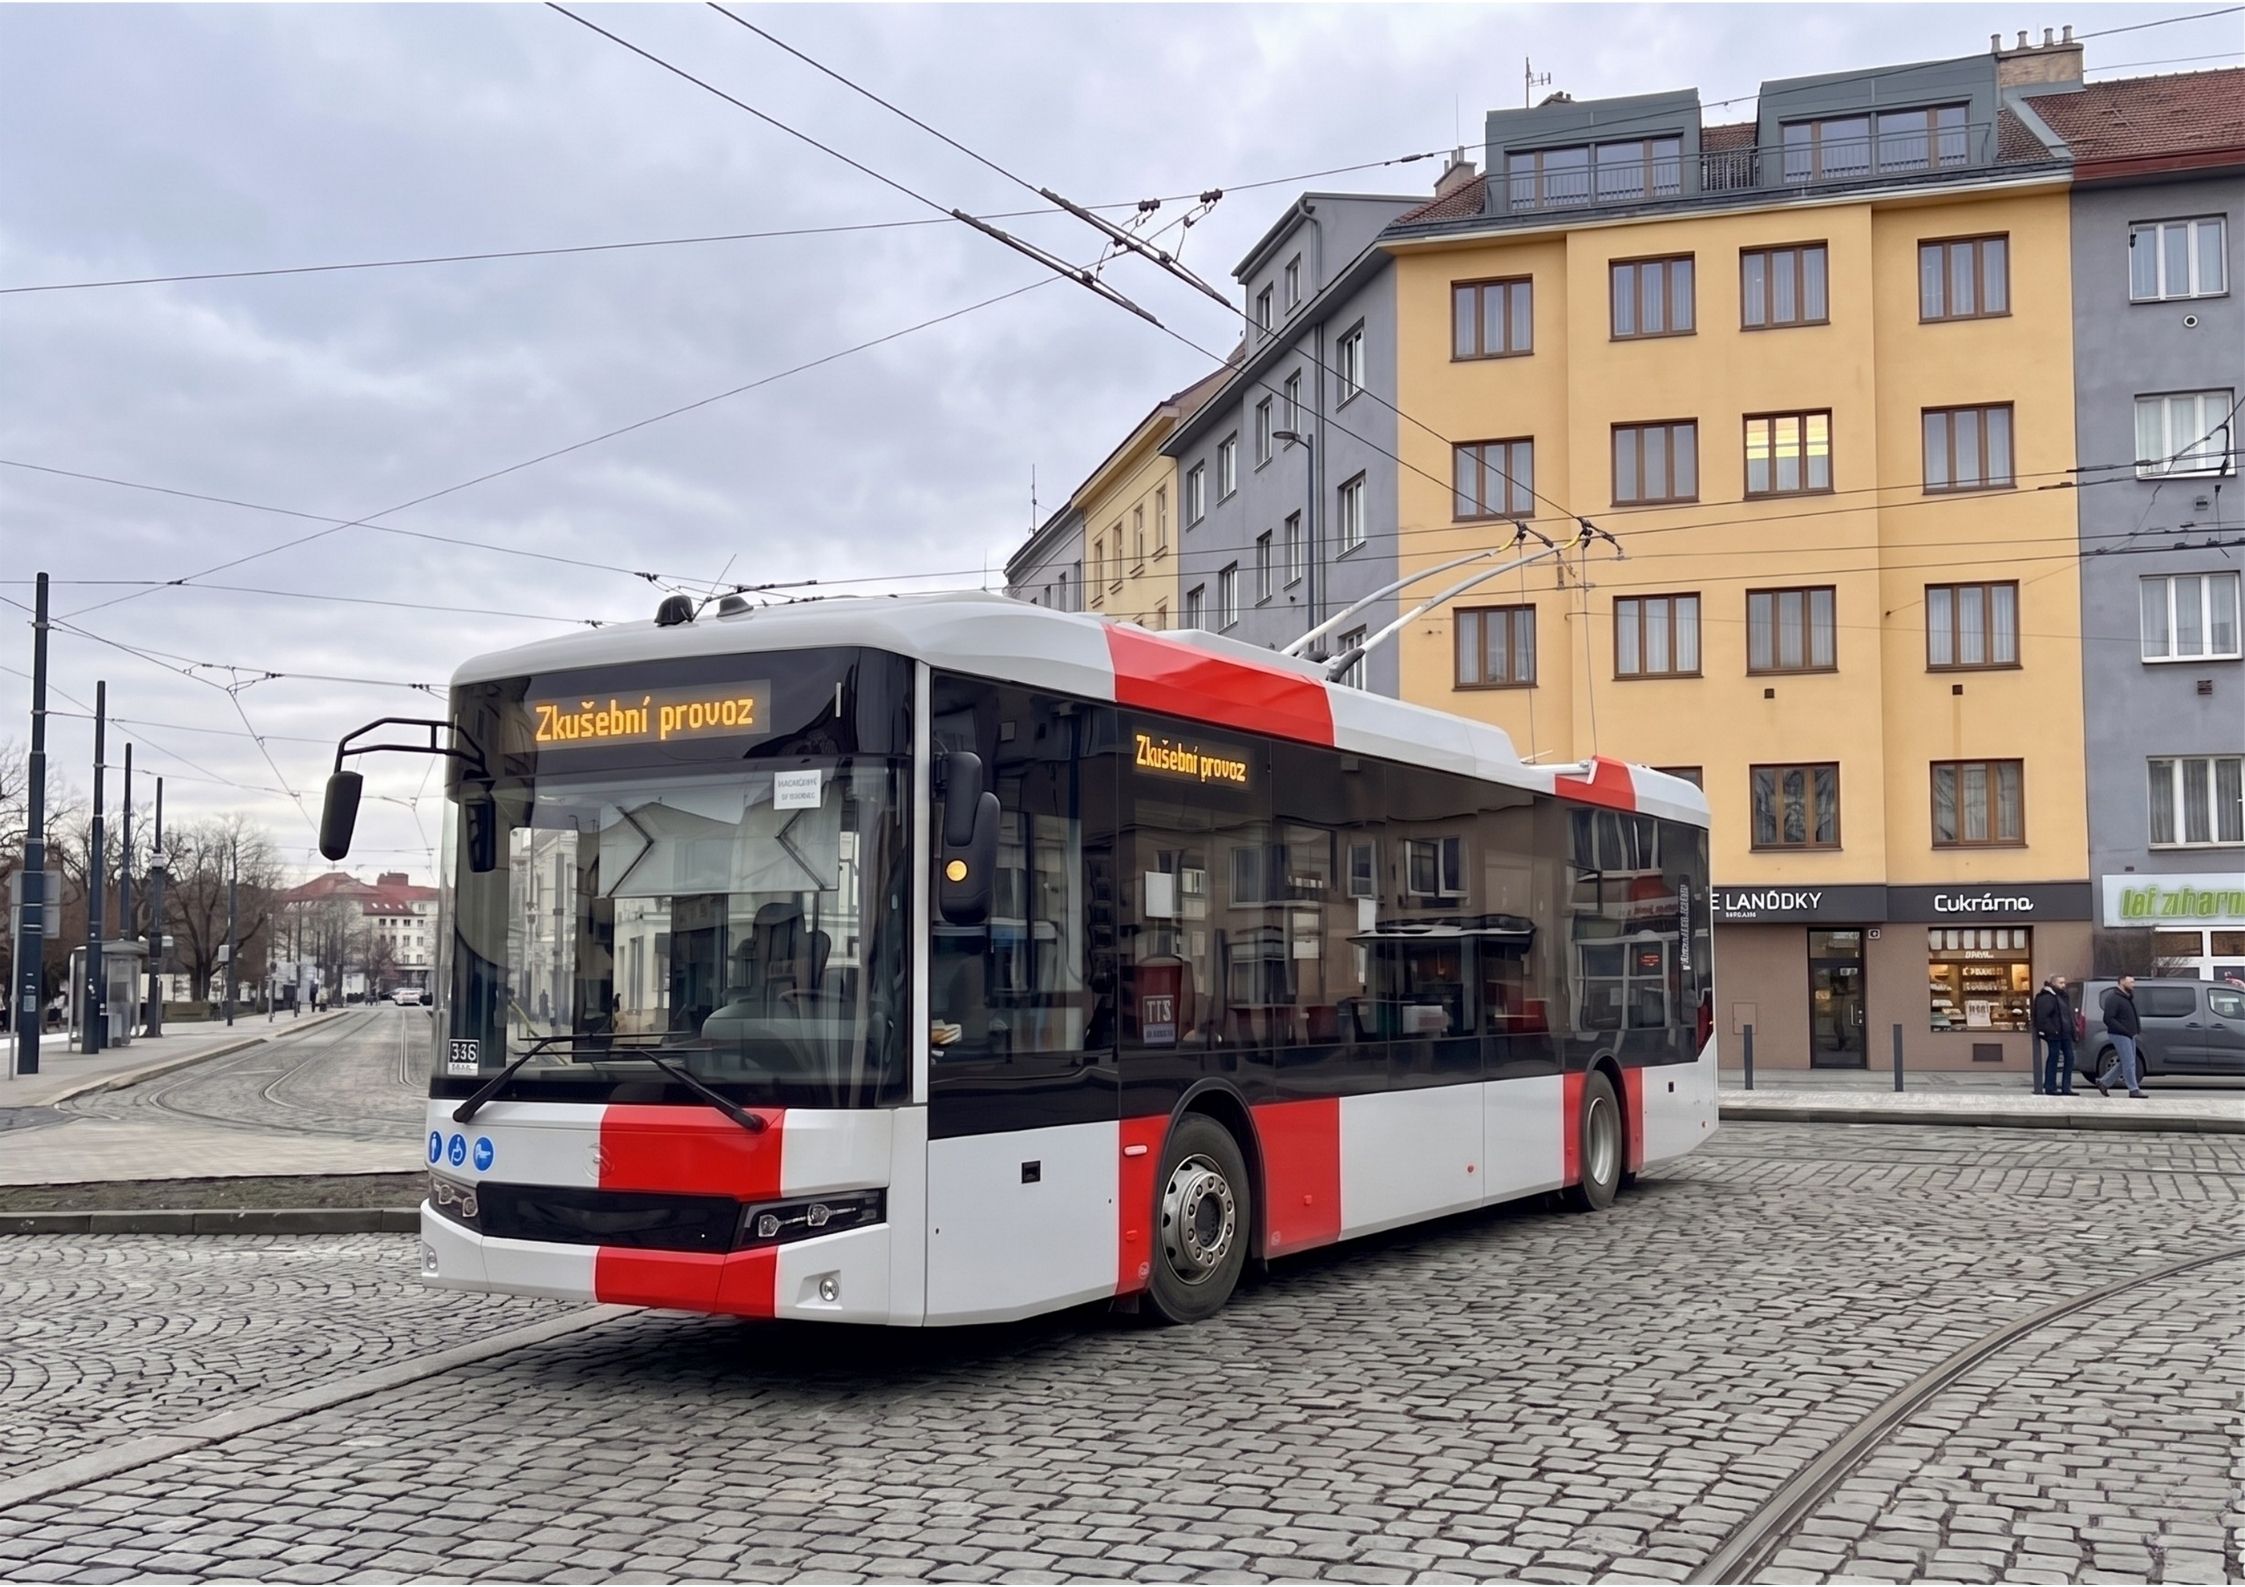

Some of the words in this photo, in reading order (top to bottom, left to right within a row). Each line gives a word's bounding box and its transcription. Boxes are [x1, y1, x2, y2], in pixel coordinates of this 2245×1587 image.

[535, 695, 651, 742] Zkušební
[659, 698, 753, 741] provoz
[1135, 734, 1199, 774] Zkušební
[1200, 755, 1246, 782] provoz
[1933, 892, 2034, 912] Cukrárna
